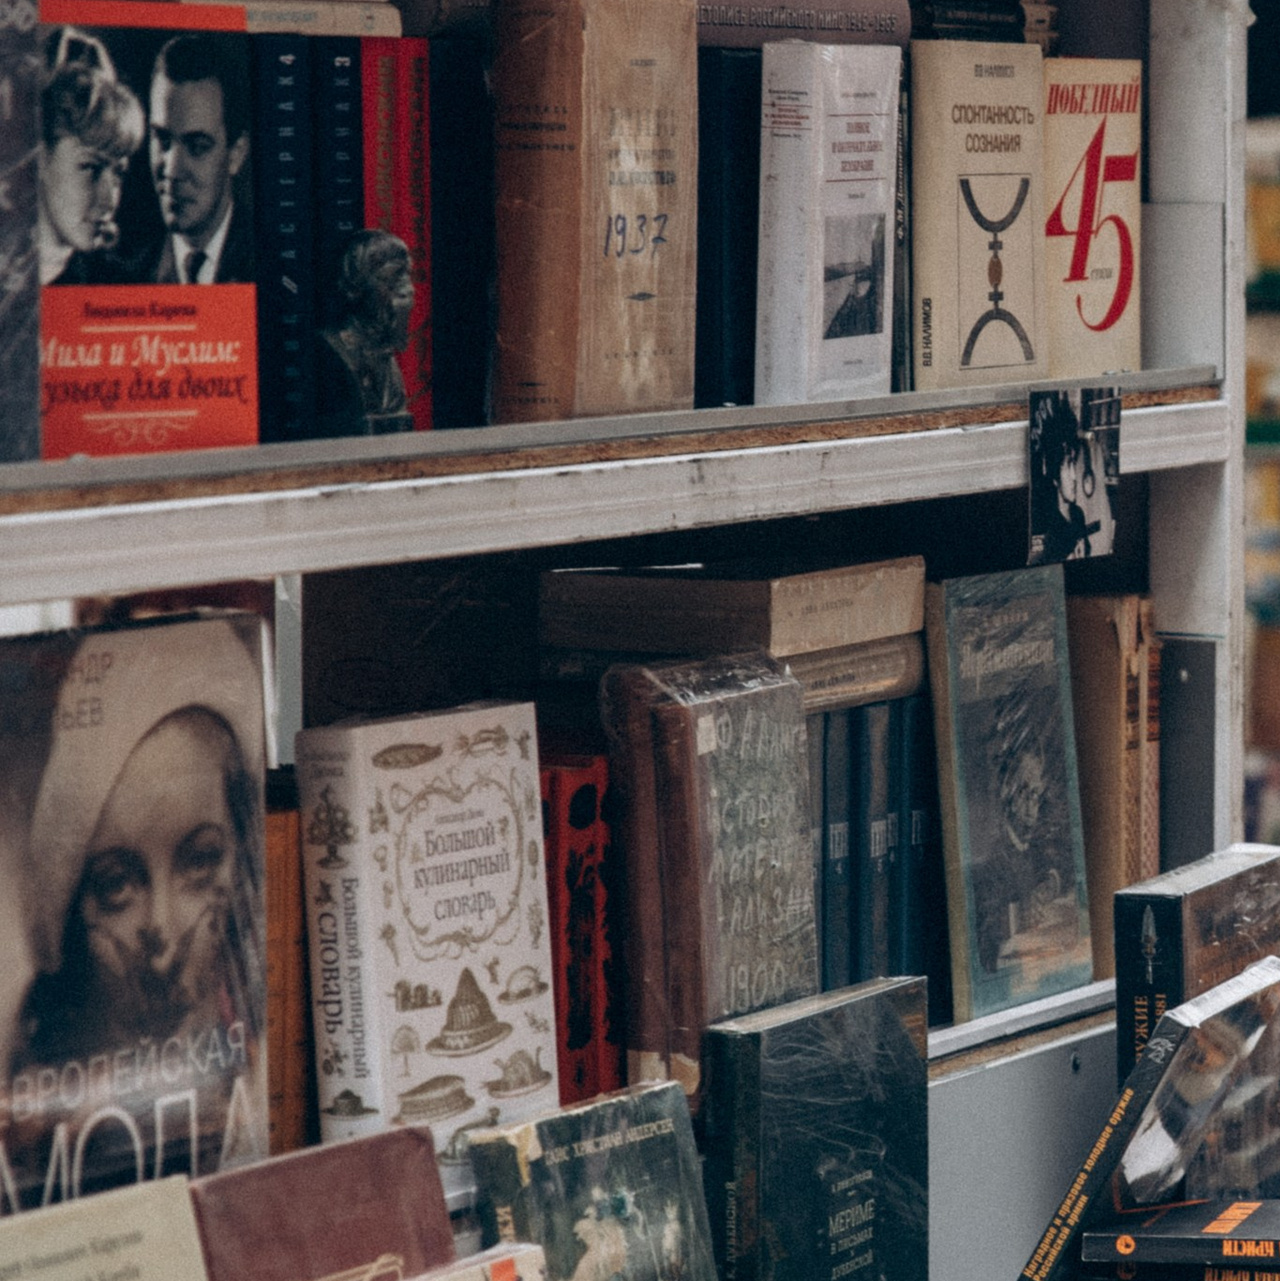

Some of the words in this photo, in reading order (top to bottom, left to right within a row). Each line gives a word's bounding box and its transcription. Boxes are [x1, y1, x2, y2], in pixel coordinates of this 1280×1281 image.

[749, 5, 816, 29] РОССИЙСКОГО
[952, 104, 1034, 125] СПОНТАННОСТЬ
[1046, 75, 1140, 115] ПОБЕДНЫЙ
[334, 77, 353, 231] СТЕРНАК
[965, 133, 1021, 153] СОЗНАНИЯ
[1045, 116, 1139, 332] 45
[922, 298, 932, 350] НАЛИМОВ
[41, 376, 122, 416] узыка
[424, 820, 496, 857] Большой
[414, 847, 511, 895] кулинарный
[341, 876, 363, 961] Большой
[434, 890, 496, 920] словарь
[318, 912, 345, 1033] словарь
[346, 965, 371, 1080] кулинарный
[10, 1020, 249, 1122] ВРОПЕЙСКАЯ
[1022, 1226, 1058, 1277] Наградное
[1059, 1171, 1088, 1219] призовое
[1083, 1125, 1114, 1172] холодное
[1109, 1086, 1136, 1126] оружие
[828, 1198, 876, 1237] МЕРИМЕ
[1067, 1193, 1090, 1226] армии
[1222, 1239, 1275, 1258] КРИСТИ
